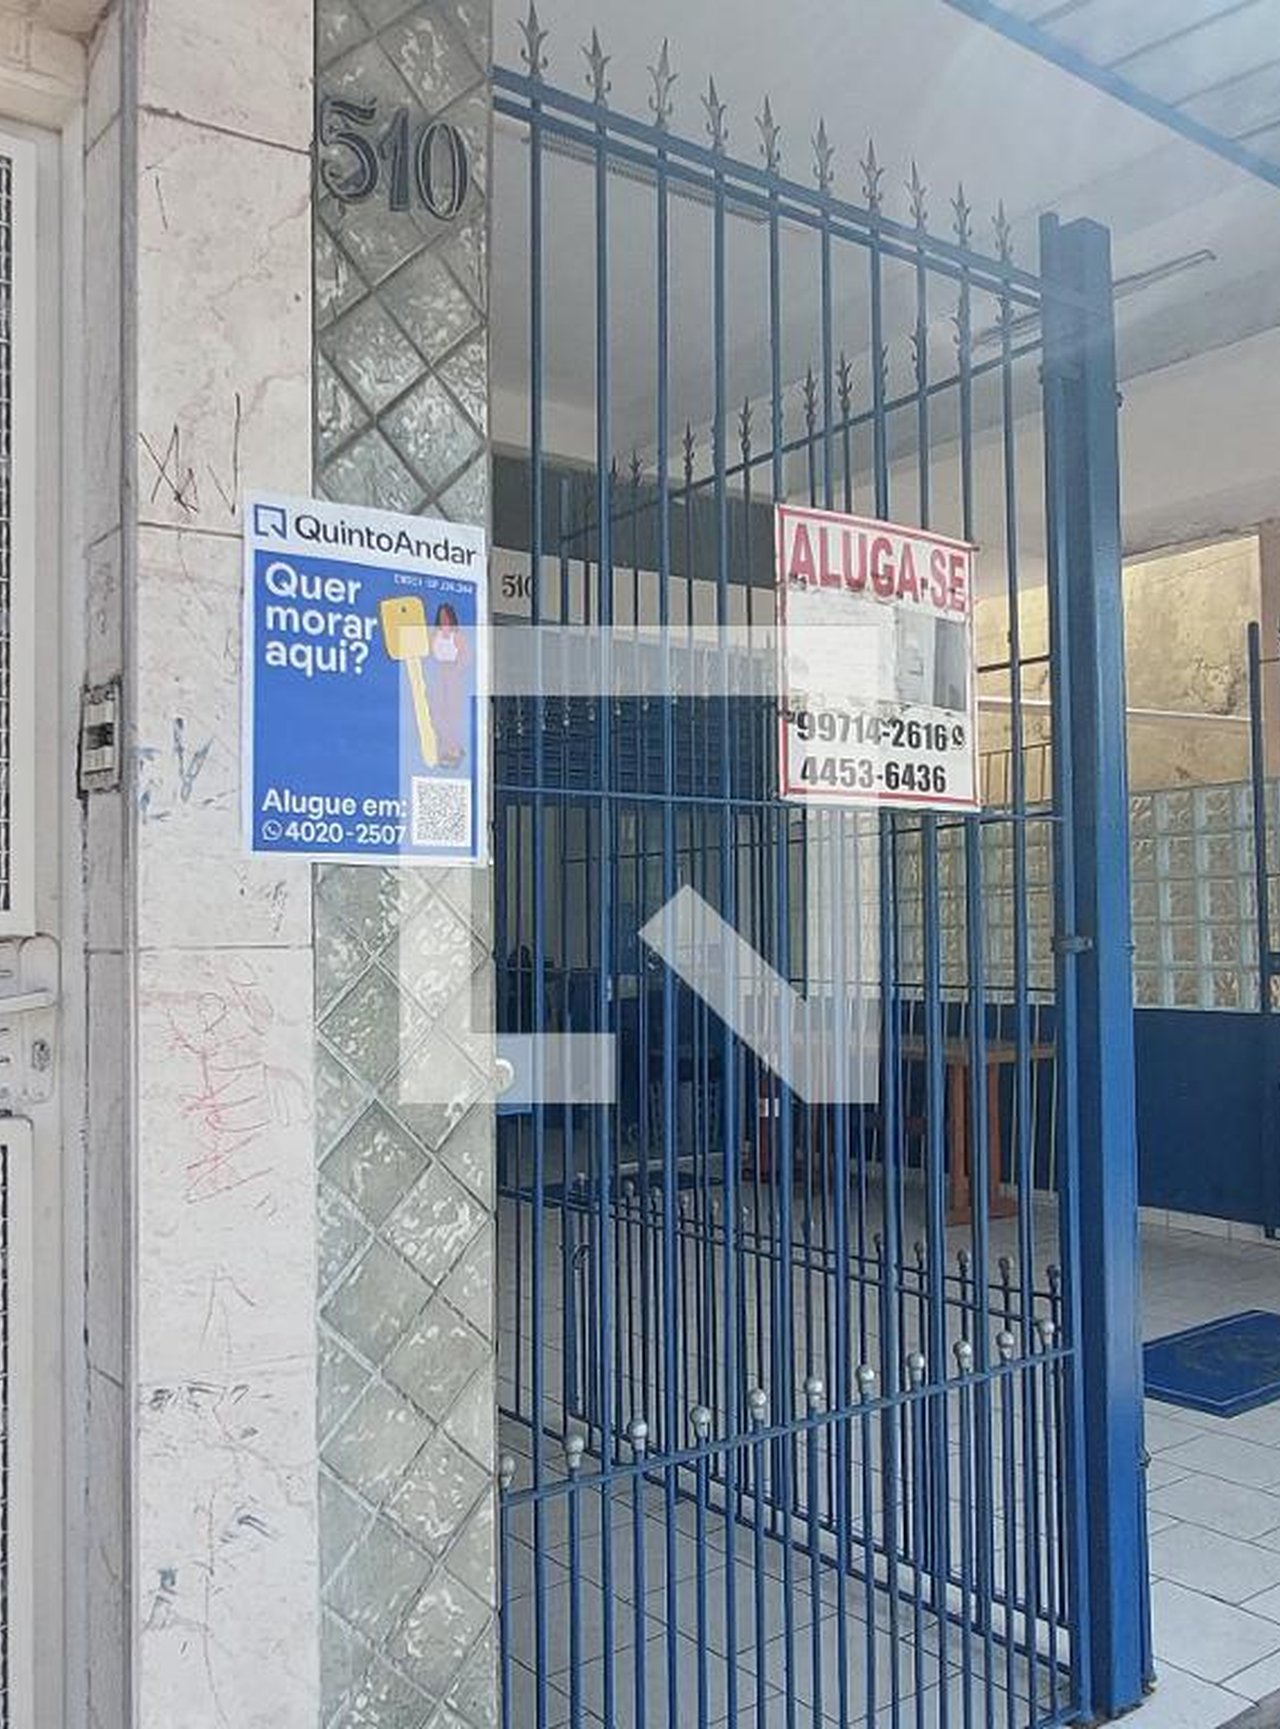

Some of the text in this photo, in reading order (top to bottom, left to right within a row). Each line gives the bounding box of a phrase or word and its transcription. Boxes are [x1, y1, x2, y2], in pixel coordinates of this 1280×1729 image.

[320, 98, 468, 221] 510
[295, 514, 476, 566] QuintoAndar
[265, 562, 362, 604] Quer
[790, 523, 965, 613] ALUGA-SE
[266, 604, 377, 640] morar
[265, 641, 369, 678] aqui?
[796, 711, 948, 751] 99714-2616
[801, 756, 946, 793] 4453-6436
[261, 789, 408, 818] Alugue em:
[285, 821, 407, 845] 4020-2507
